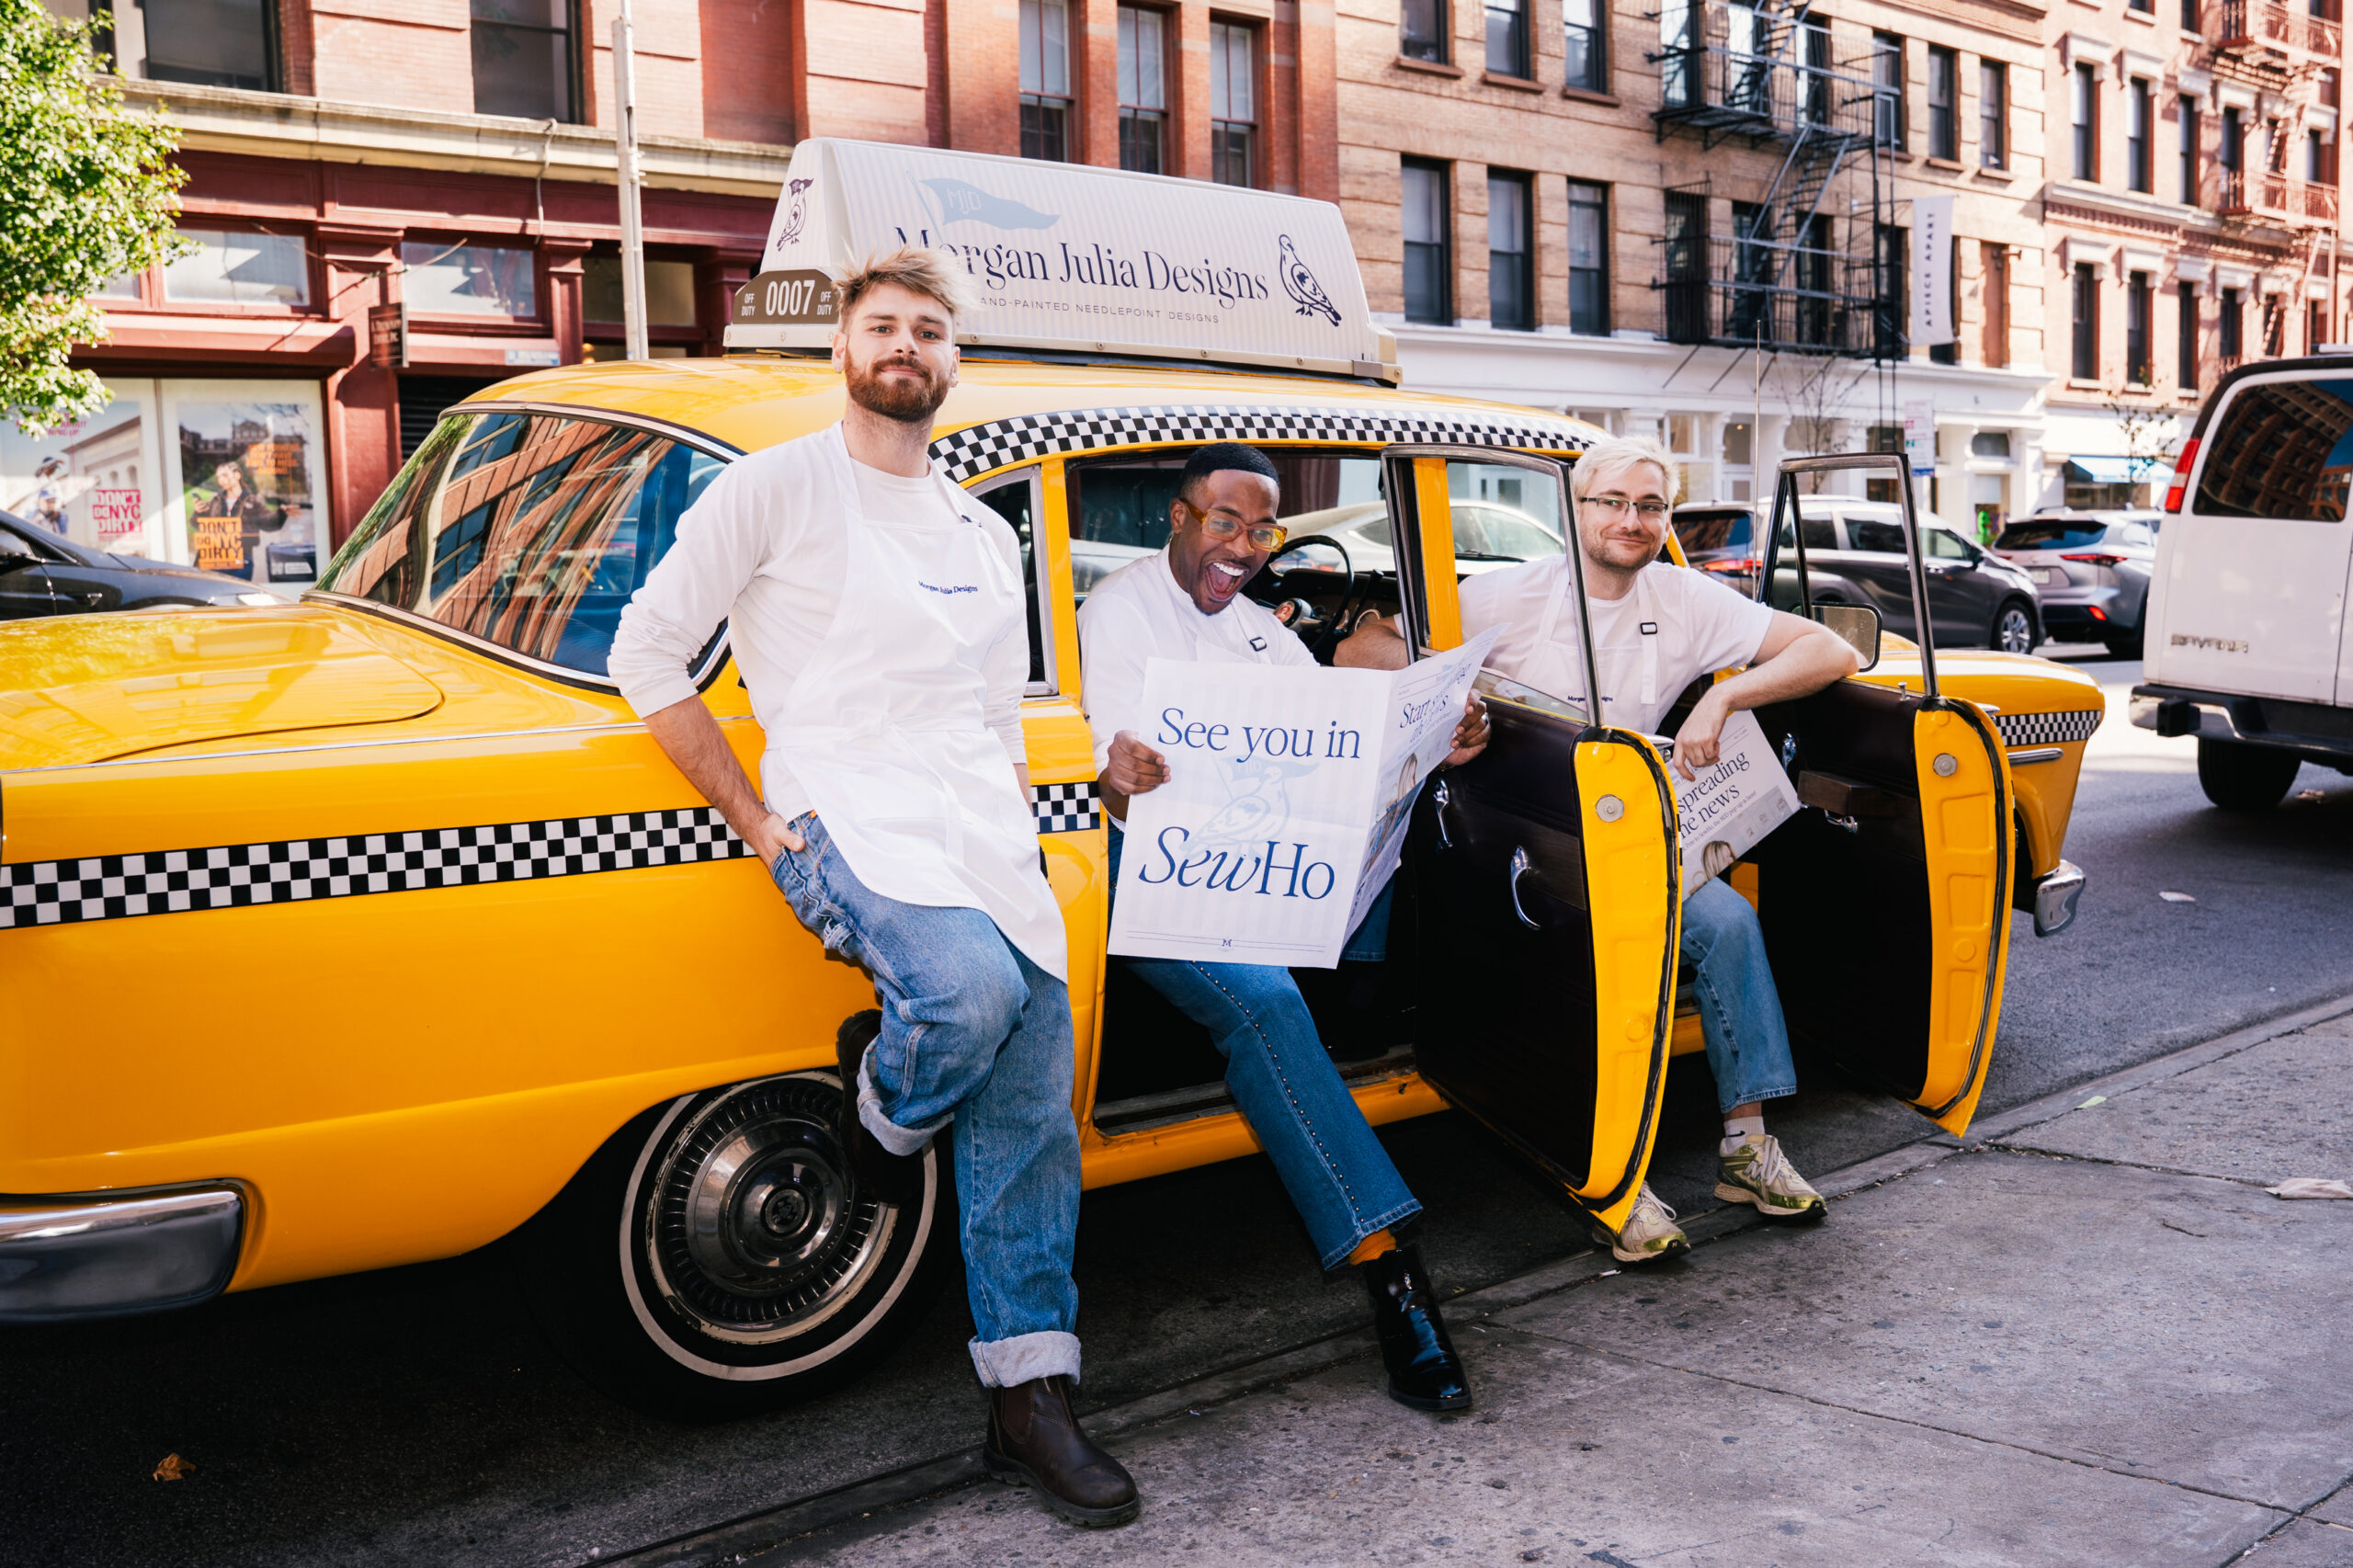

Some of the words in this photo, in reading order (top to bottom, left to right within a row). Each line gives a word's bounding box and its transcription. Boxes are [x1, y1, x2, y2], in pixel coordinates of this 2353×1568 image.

[948, 187, 983, 214] MJD
[1059, 242, 1140, 289] Julia
[1142, 250, 1269, 310] Designs
[744, 293, 756, 304] OFF
[765, 279, 816, 316] 0007
[820, 290, 832, 302] OFF
[741, 305, 756, 316] DUTY
[816, 304, 833, 316] DUTY
[980, 297, 1070, 312] AND-PAINTED
[1075, 303, 1162, 319] NEEDLEPOINT
[1168, 311, 1220, 324] DESIGNS
[109, 505, 141, 519] NYC
[210, 533, 242, 547] NYC
[1400, 699, 1431, 728] Start
[1157, 707, 1229, 751] See
[1235, 725, 1313, 763] you
[1324, 720, 1361, 759] in
[1677, 751, 1750, 813] spreading
[1680, 816, 1699, 839] he
[1698, 784, 1740, 823] news
[1138, 826, 1336, 900] SewHo
